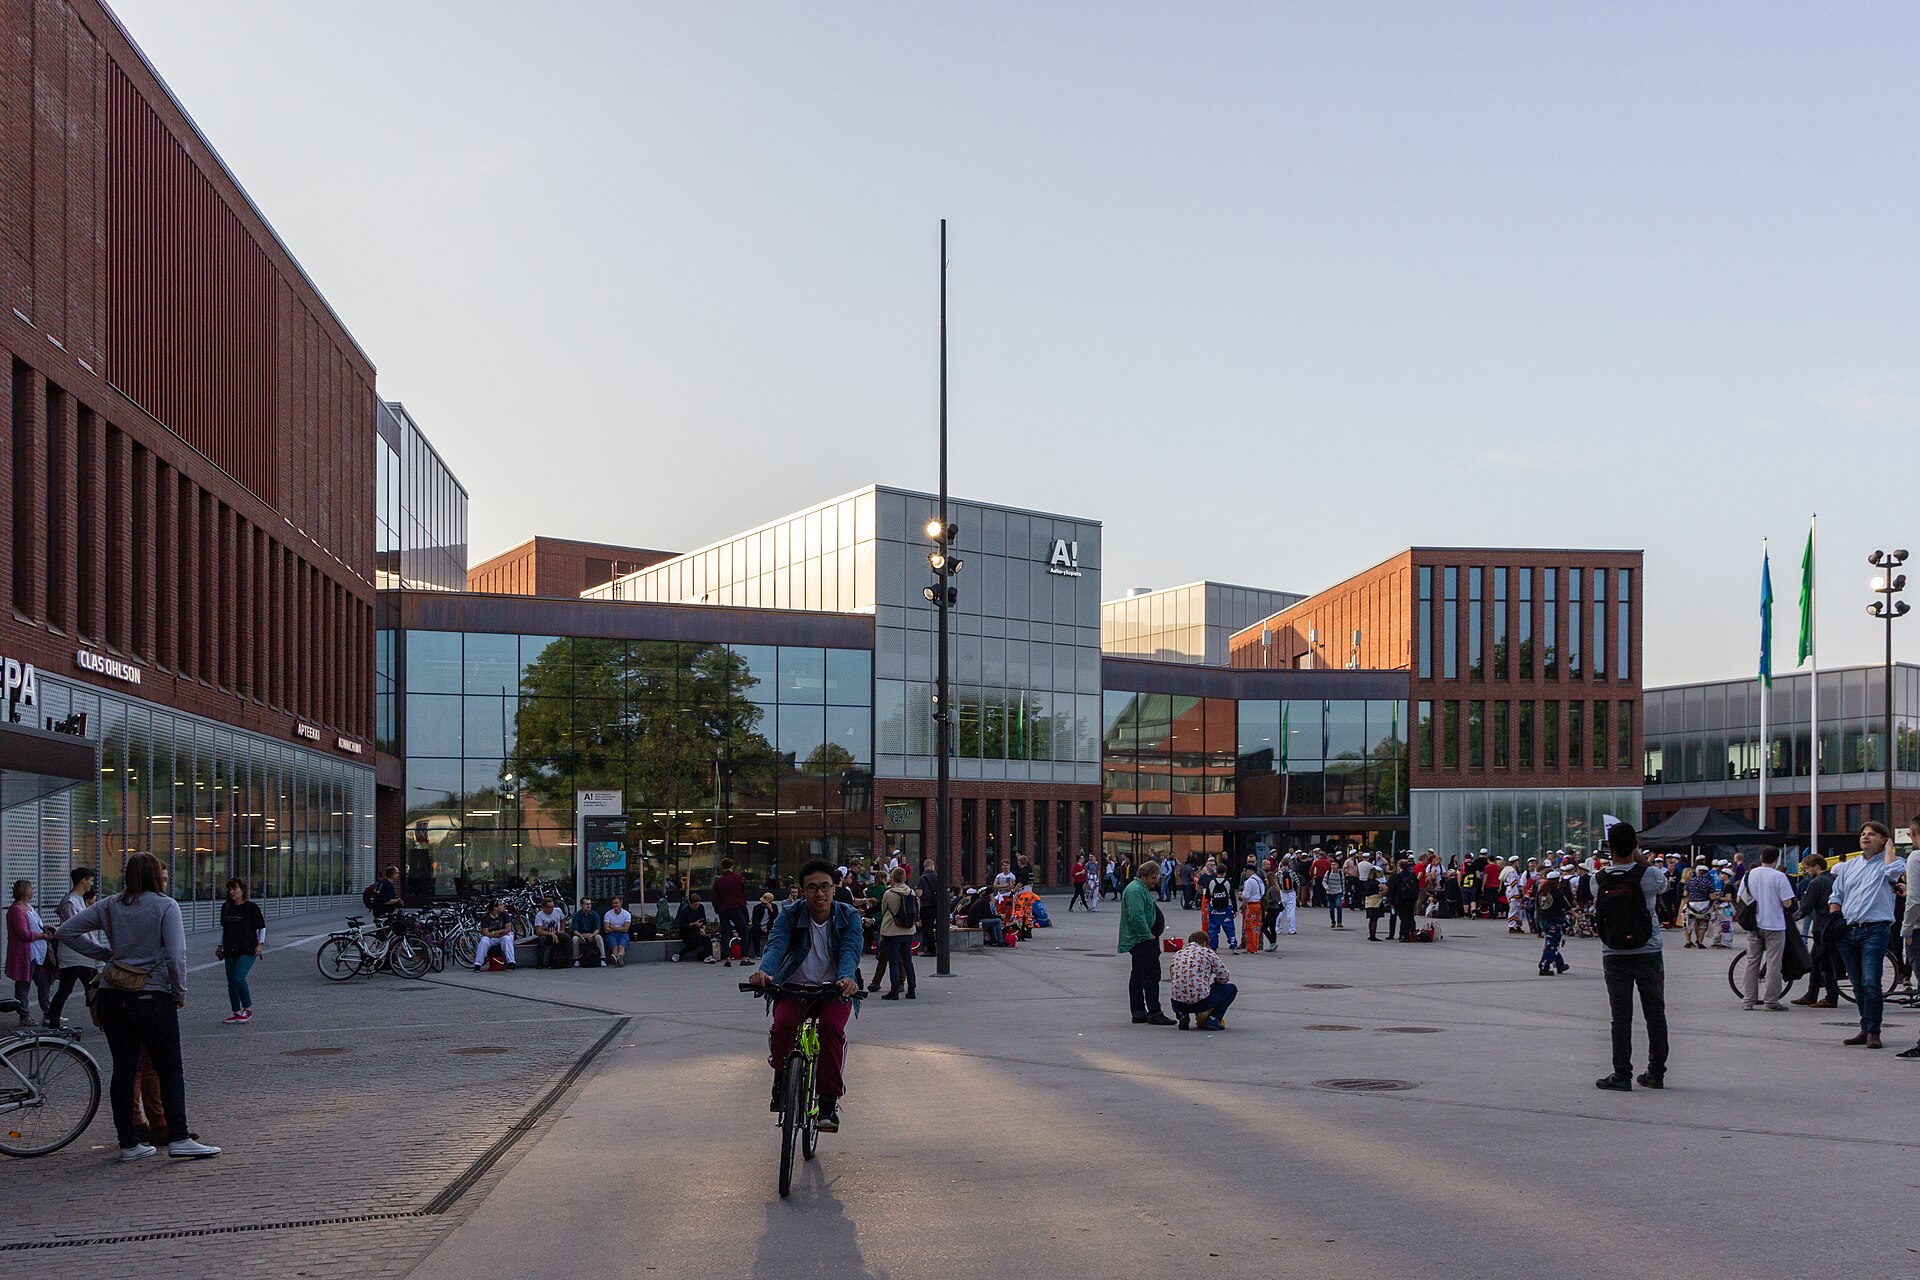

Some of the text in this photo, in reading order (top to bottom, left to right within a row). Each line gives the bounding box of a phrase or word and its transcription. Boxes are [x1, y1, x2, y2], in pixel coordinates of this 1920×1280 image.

[1051, 539, 1078, 567] A!
[0, 656, 37, 706] PA
[77, 650, 141, 684] CLAS OHLSON
[297, 722, 320, 741] APTEEKKI
[886, 806, 913, 816] Brooklyn
